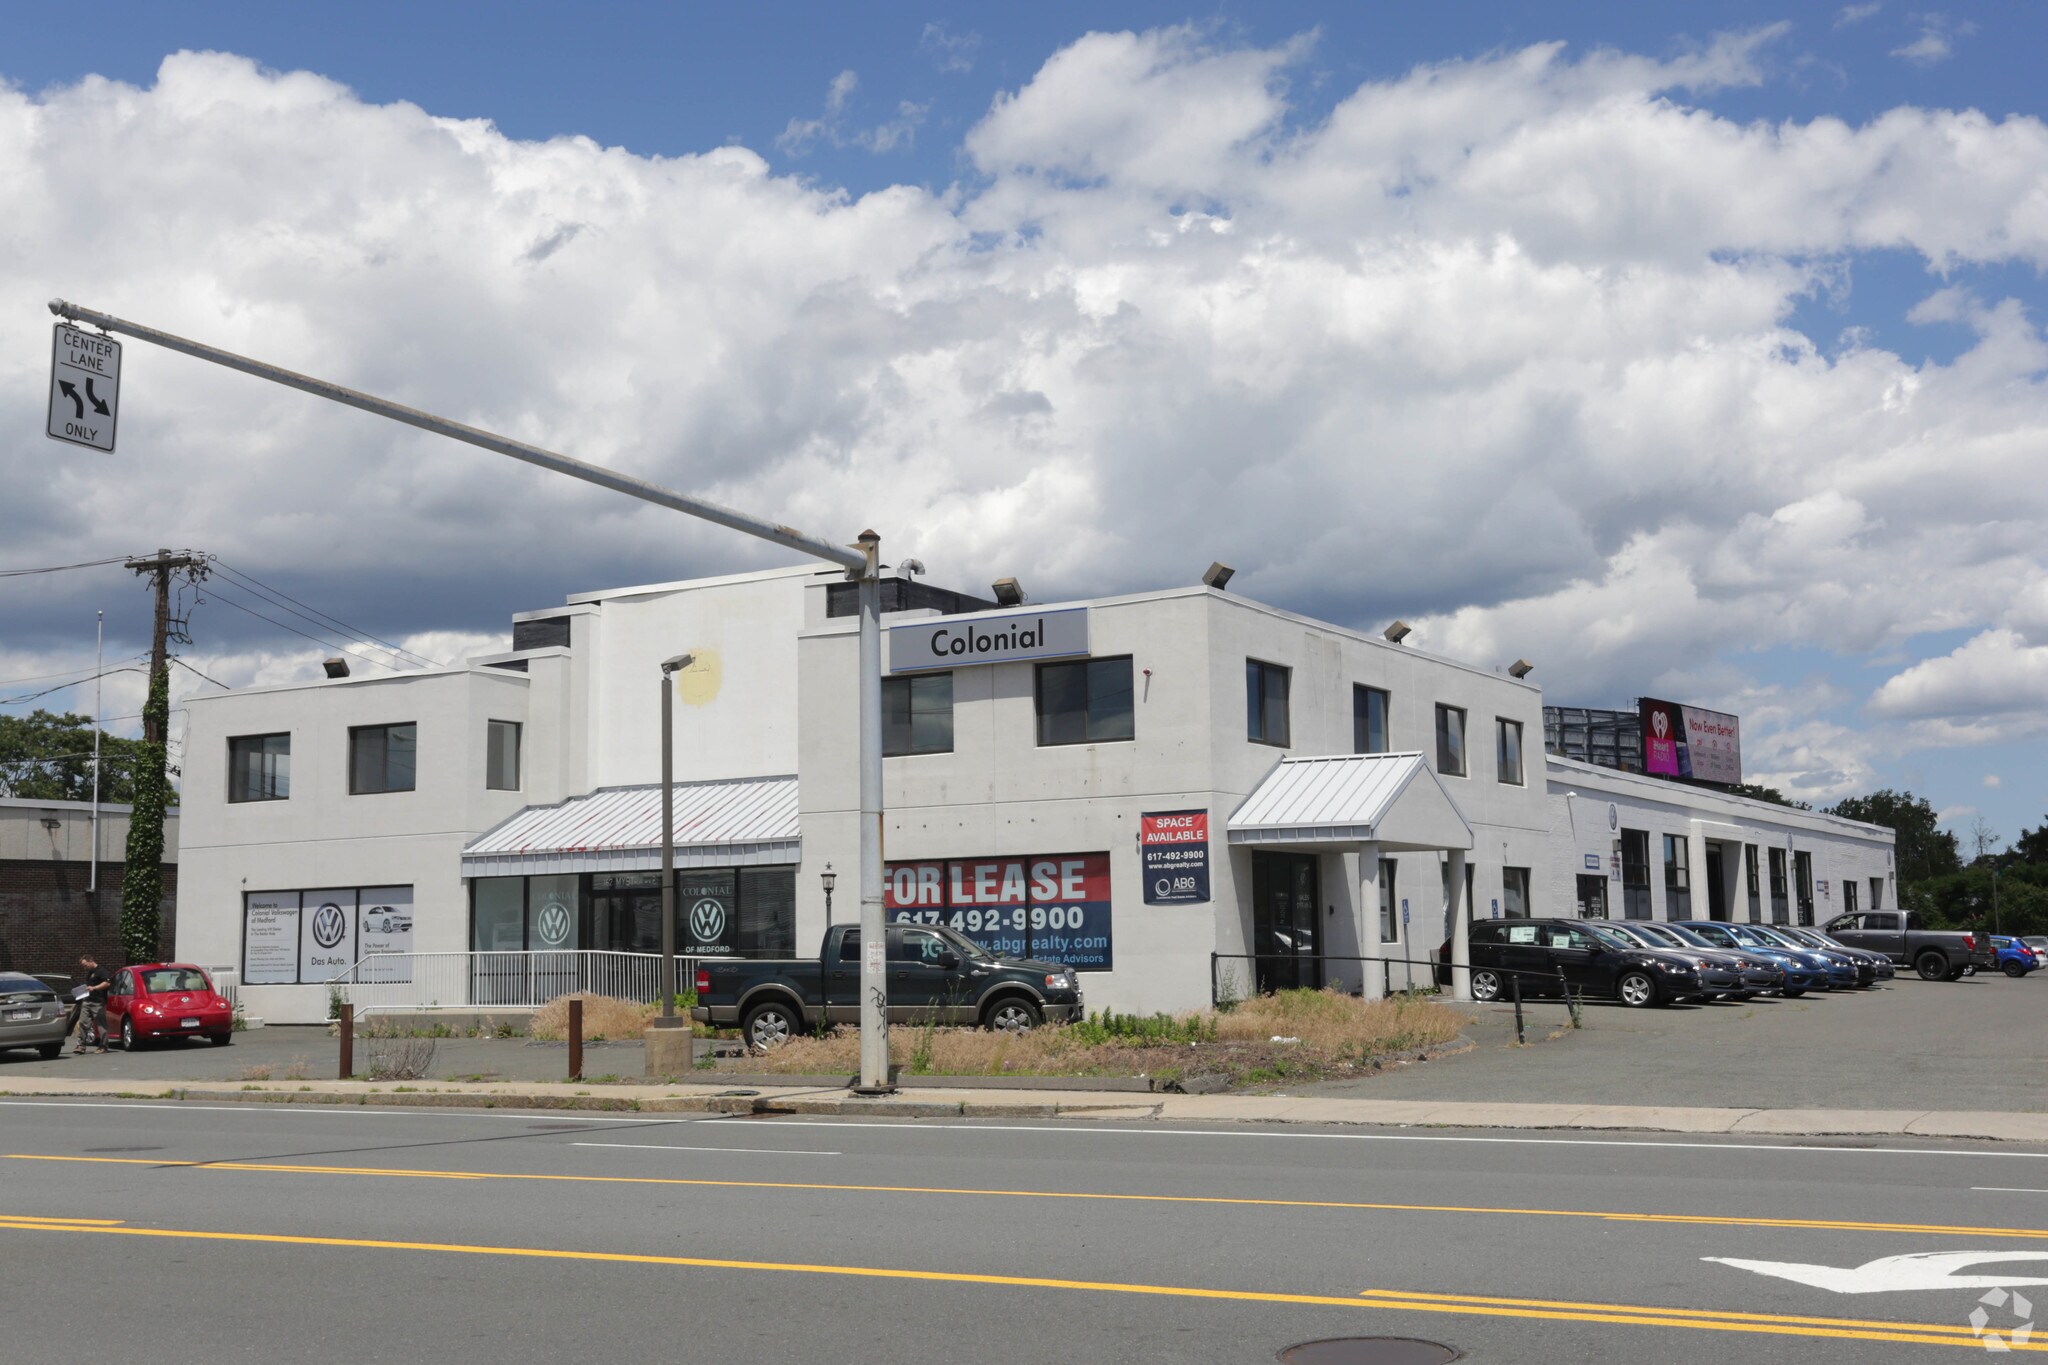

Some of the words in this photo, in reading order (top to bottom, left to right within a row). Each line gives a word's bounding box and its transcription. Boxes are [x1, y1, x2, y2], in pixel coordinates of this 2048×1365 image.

[64, 332, 112, 358] CENTER
[71, 350, 104, 372] LANE
[65, 422, 98, 441] ONLY
[930, 618, 1044, 657] Colonial
[1689, 719, 1703, 732] Now
[1704, 721, 1716, 734] Even
[1156, 816, 1192, 828] SPACE
[1147, 830, 1203, 842] AVAILABLE
[1147, 850, 1204, 861] 617-492-9900
[1148, 862, 1204, 870] www.abgrealty.com
[951, 860, 1086, 904] LEASE
[1173, 877, 1195, 889] ABG
[682, 886, 732, 896] COLONIAL
[271, 908, 298, 916] Volkswagen
[696, 945, 730, 953] MEDFORD
[977, 935, 1108, 954] w.abgrealty.com
[311, 956, 325, 966] Das
[327, 956, 347, 966] Auto.
[1062, 954, 1104, 963] Advisors
